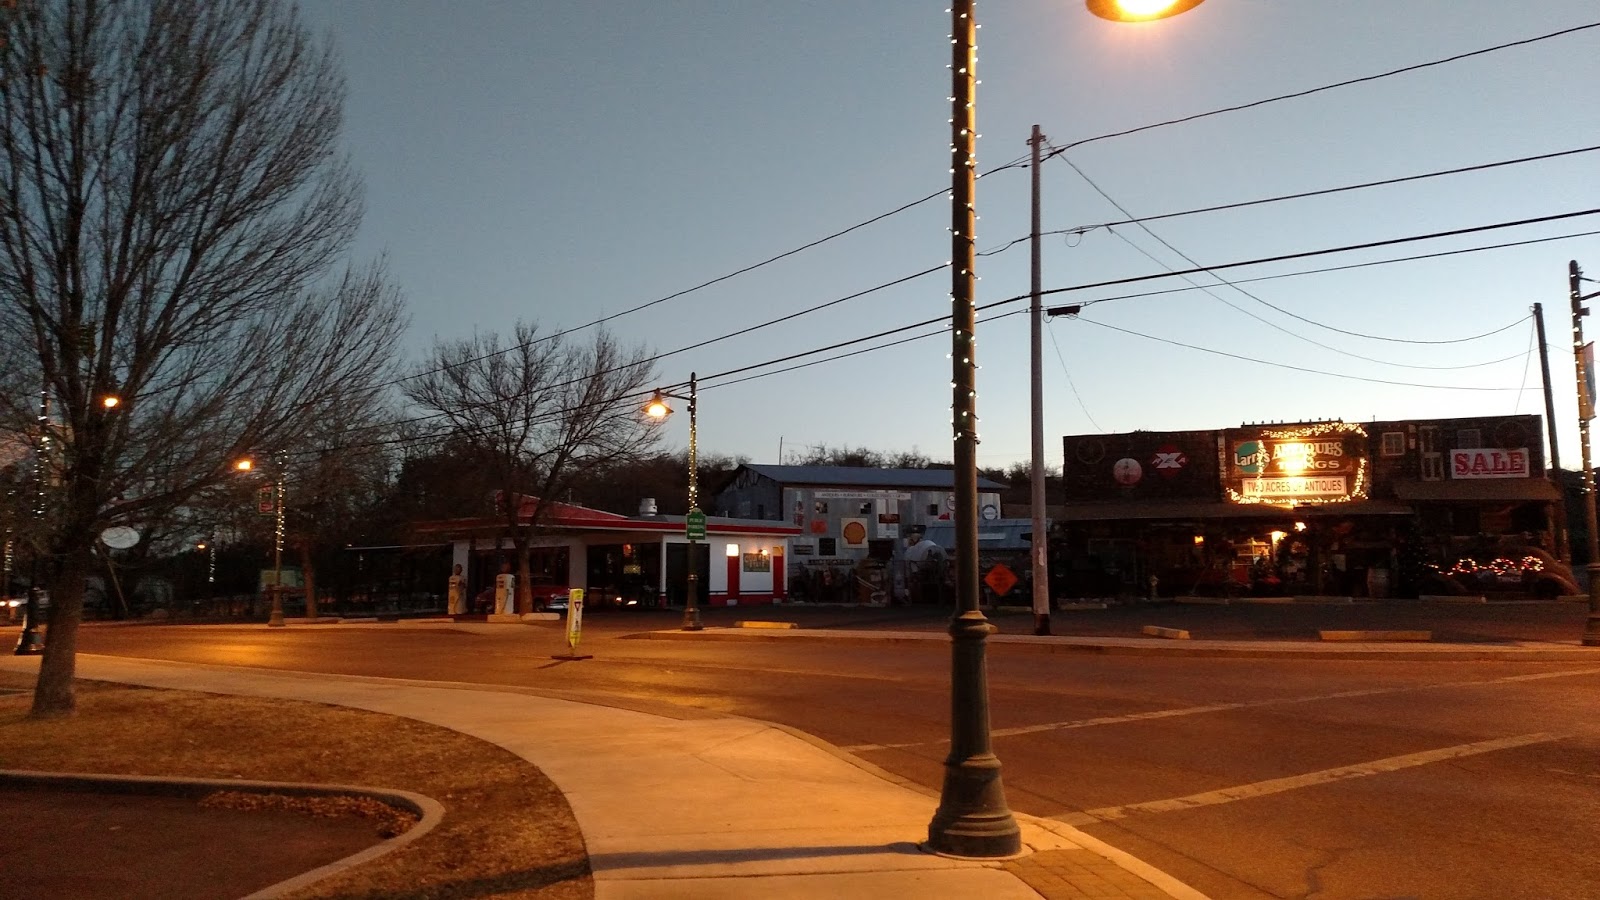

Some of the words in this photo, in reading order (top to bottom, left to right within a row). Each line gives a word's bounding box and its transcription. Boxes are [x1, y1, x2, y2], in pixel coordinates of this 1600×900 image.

[1272, 441, 1343, 459] AQUES
[1234, 452, 1270, 466] Larrs
[1454, 452, 1526, 475] SALE
[1265, 481, 1291, 492] ACRES
[1305, 480, 1342, 491] ANTIQUES
